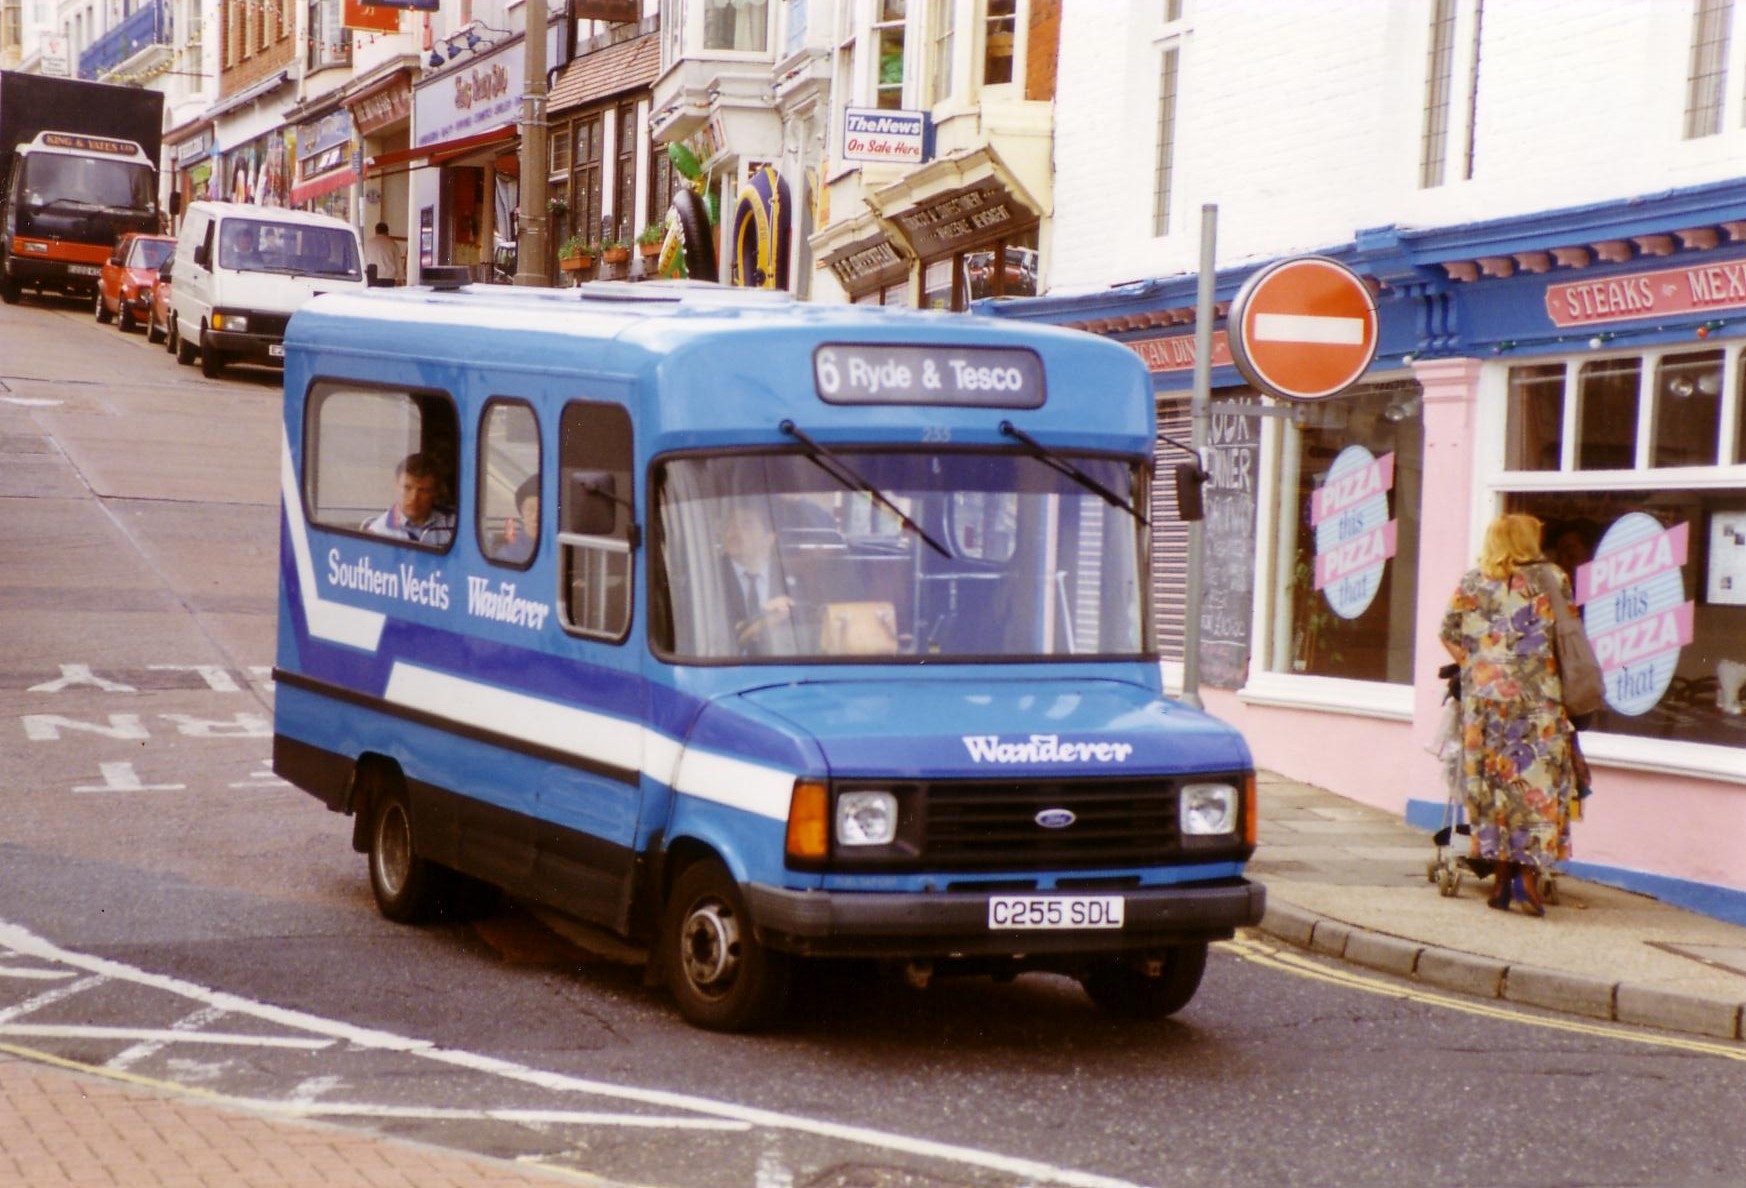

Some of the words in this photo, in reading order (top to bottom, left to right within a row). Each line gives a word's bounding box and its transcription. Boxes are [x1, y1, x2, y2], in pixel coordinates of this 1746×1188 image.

[848, 139, 864, 152] On
[868, 140, 891, 154] Sale
[894, 142, 920, 155] Here
[1566, 277, 1654, 318] STEAKS
[1687, 262, 1746, 303] MEX
[817, 350, 840, 393] 6
[849, 358, 912, 393] Ryde
[922, 358, 941, 390] &
[950, 360, 1023, 391] Tesco
[1208, 397, 1250, 444] OOK
[1320, 462, 1382, 518] PIZZA
[1338, 509, 1364, 542] this
[1324, 529, 1385, 581] PIZZA
[1589, 534, 1674, 596] PIZZA
[328, 548, 399, 599] Southern
[400, 563, 449, 611] Vectis
[1339, 572, 1368, 607] that
[467, 575, 549, 631] Wanderer
[1615, 586, 1649, 624] this
[1595, 611, 1679, 666] PIZZA
[1616, 662, 1655, 702] that
[962, 734, 1133, 763] Wanderer
[993, 901, 1062, 925] C255
[1071, 899, 1121, 925] SDL
